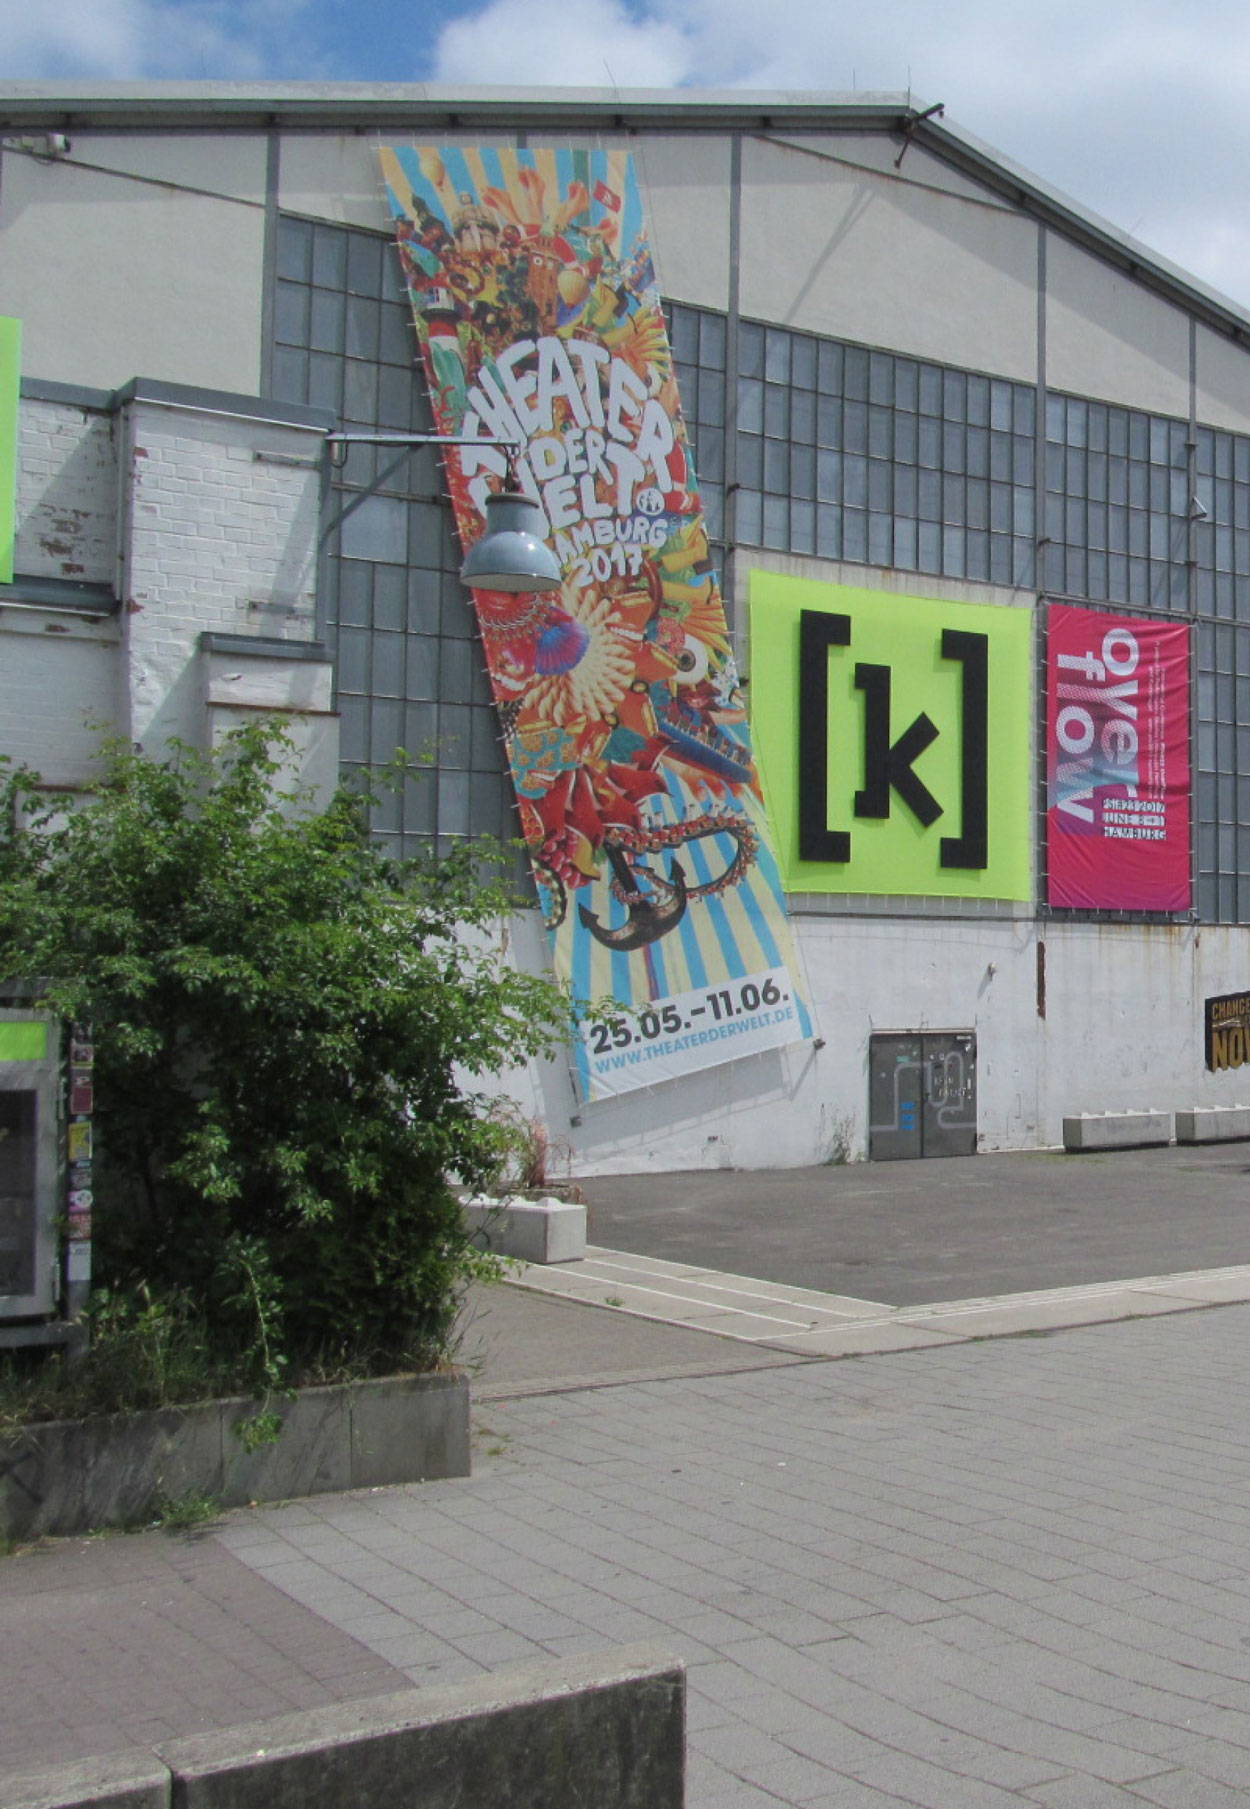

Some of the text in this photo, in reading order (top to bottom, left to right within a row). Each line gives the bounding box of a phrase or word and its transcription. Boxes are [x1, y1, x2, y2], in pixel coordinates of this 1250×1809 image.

[528, 428, 614, 486] DER
[552, 517, 670, 566] AMBURG
[571, 543, 643, 588] 2017
[1103, 826, 1167, 841] HAMBURG
[1212, 996, 1250, 1020] CHANGE
[595, 1006, 793, 1075] WWW.THEATERDERWELT.DE
